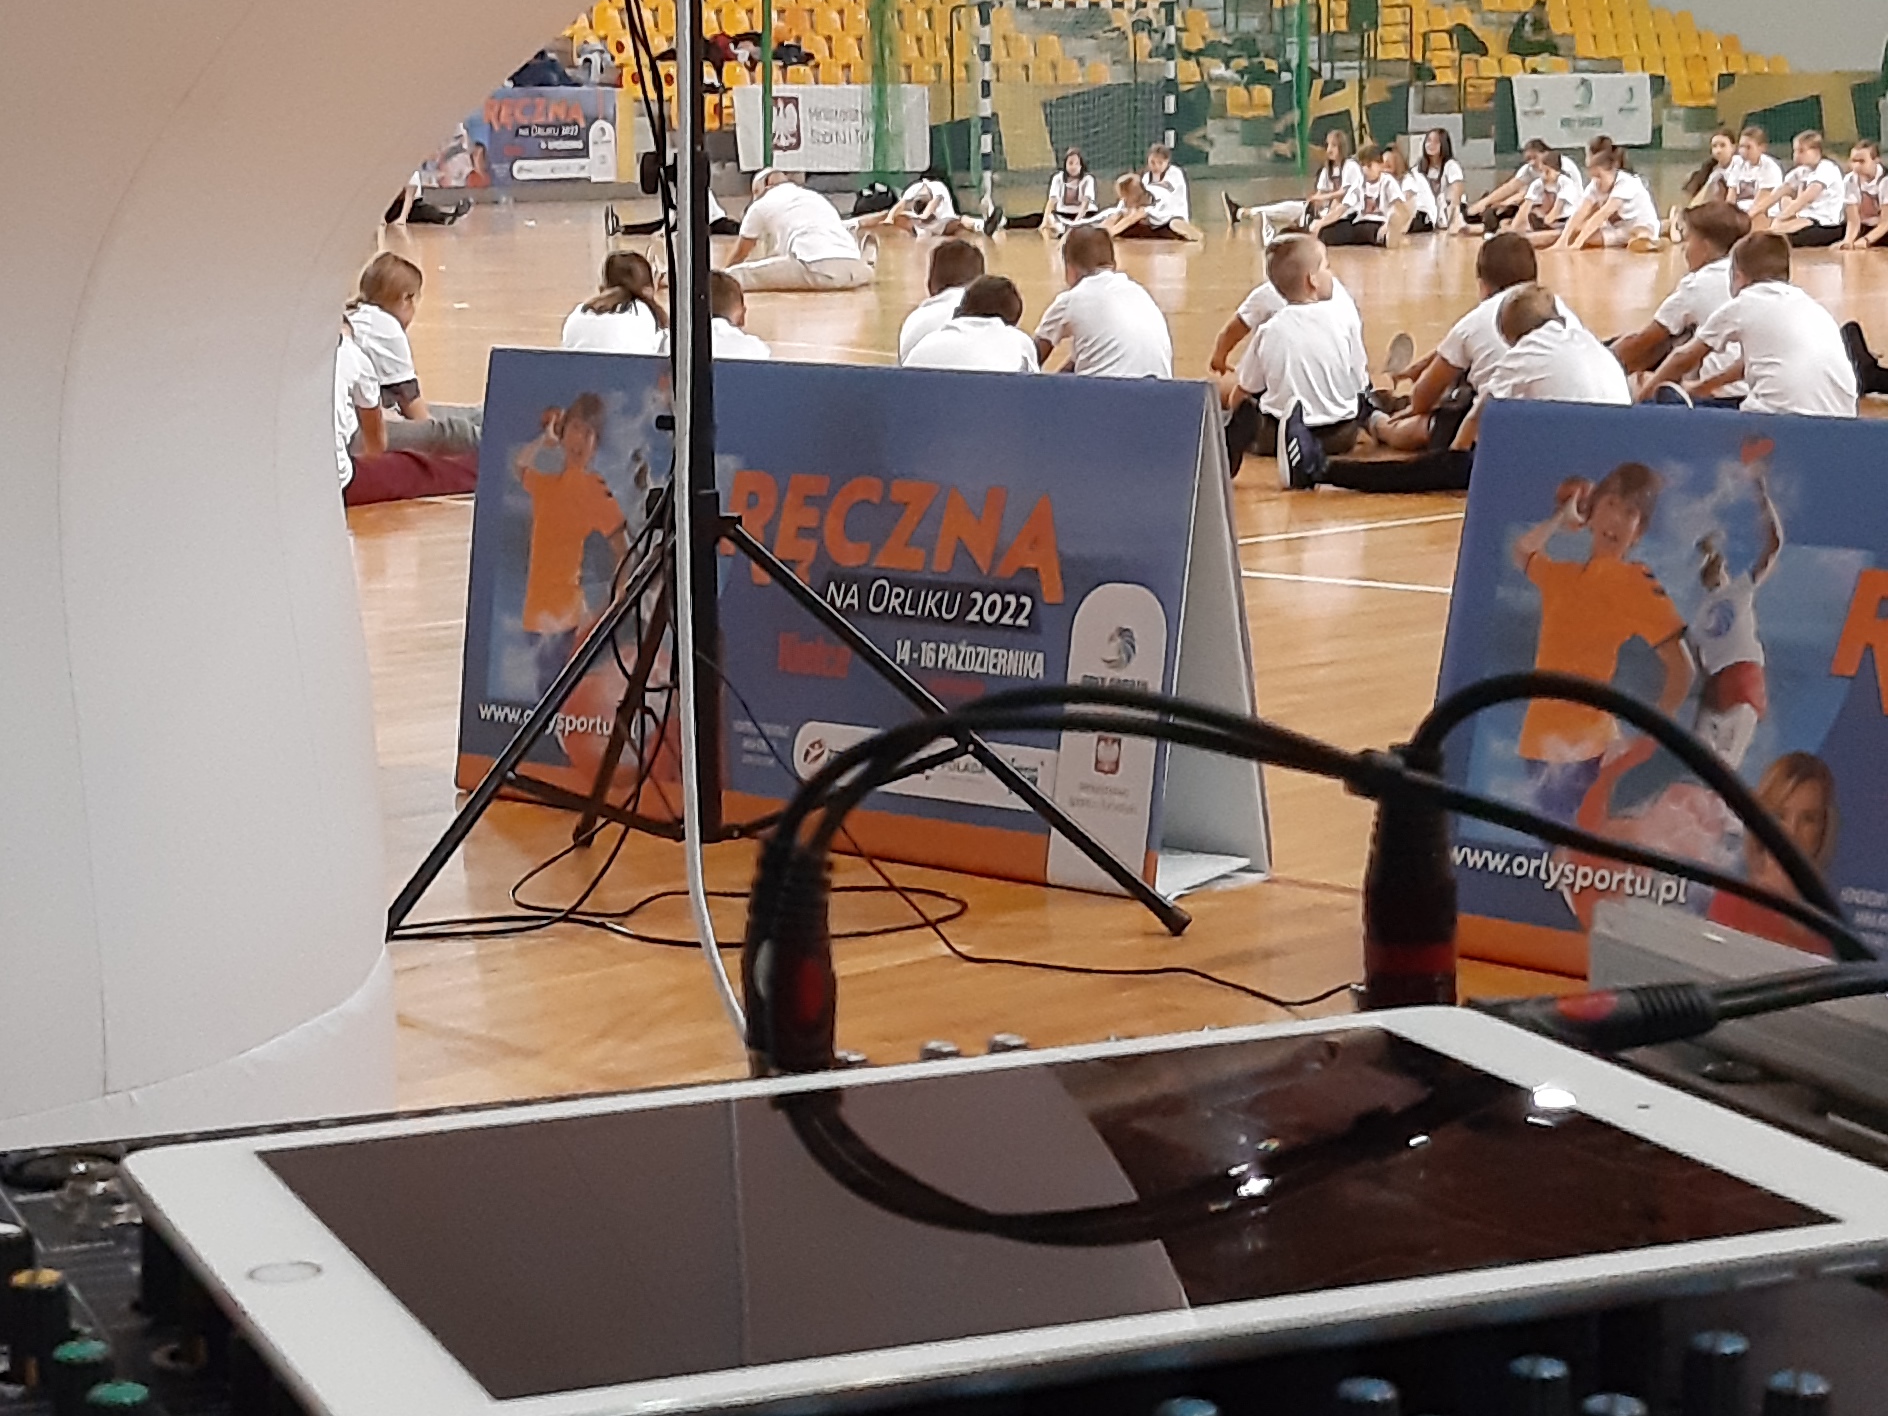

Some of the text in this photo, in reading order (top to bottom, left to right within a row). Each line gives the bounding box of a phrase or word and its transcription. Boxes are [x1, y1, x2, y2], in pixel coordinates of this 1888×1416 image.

[718, 469, 1065, 604] RĘCZNA
[825, 577, 1034, 628] NA ORLIKU 2022
[895, 639, 911, 665] 14
[920, 641, 938, 669] 16
[937, 638, 1046, 680] PAŹDZIERNIKA
[1451, 844, 1688, 906] www.orlysportu.pl
